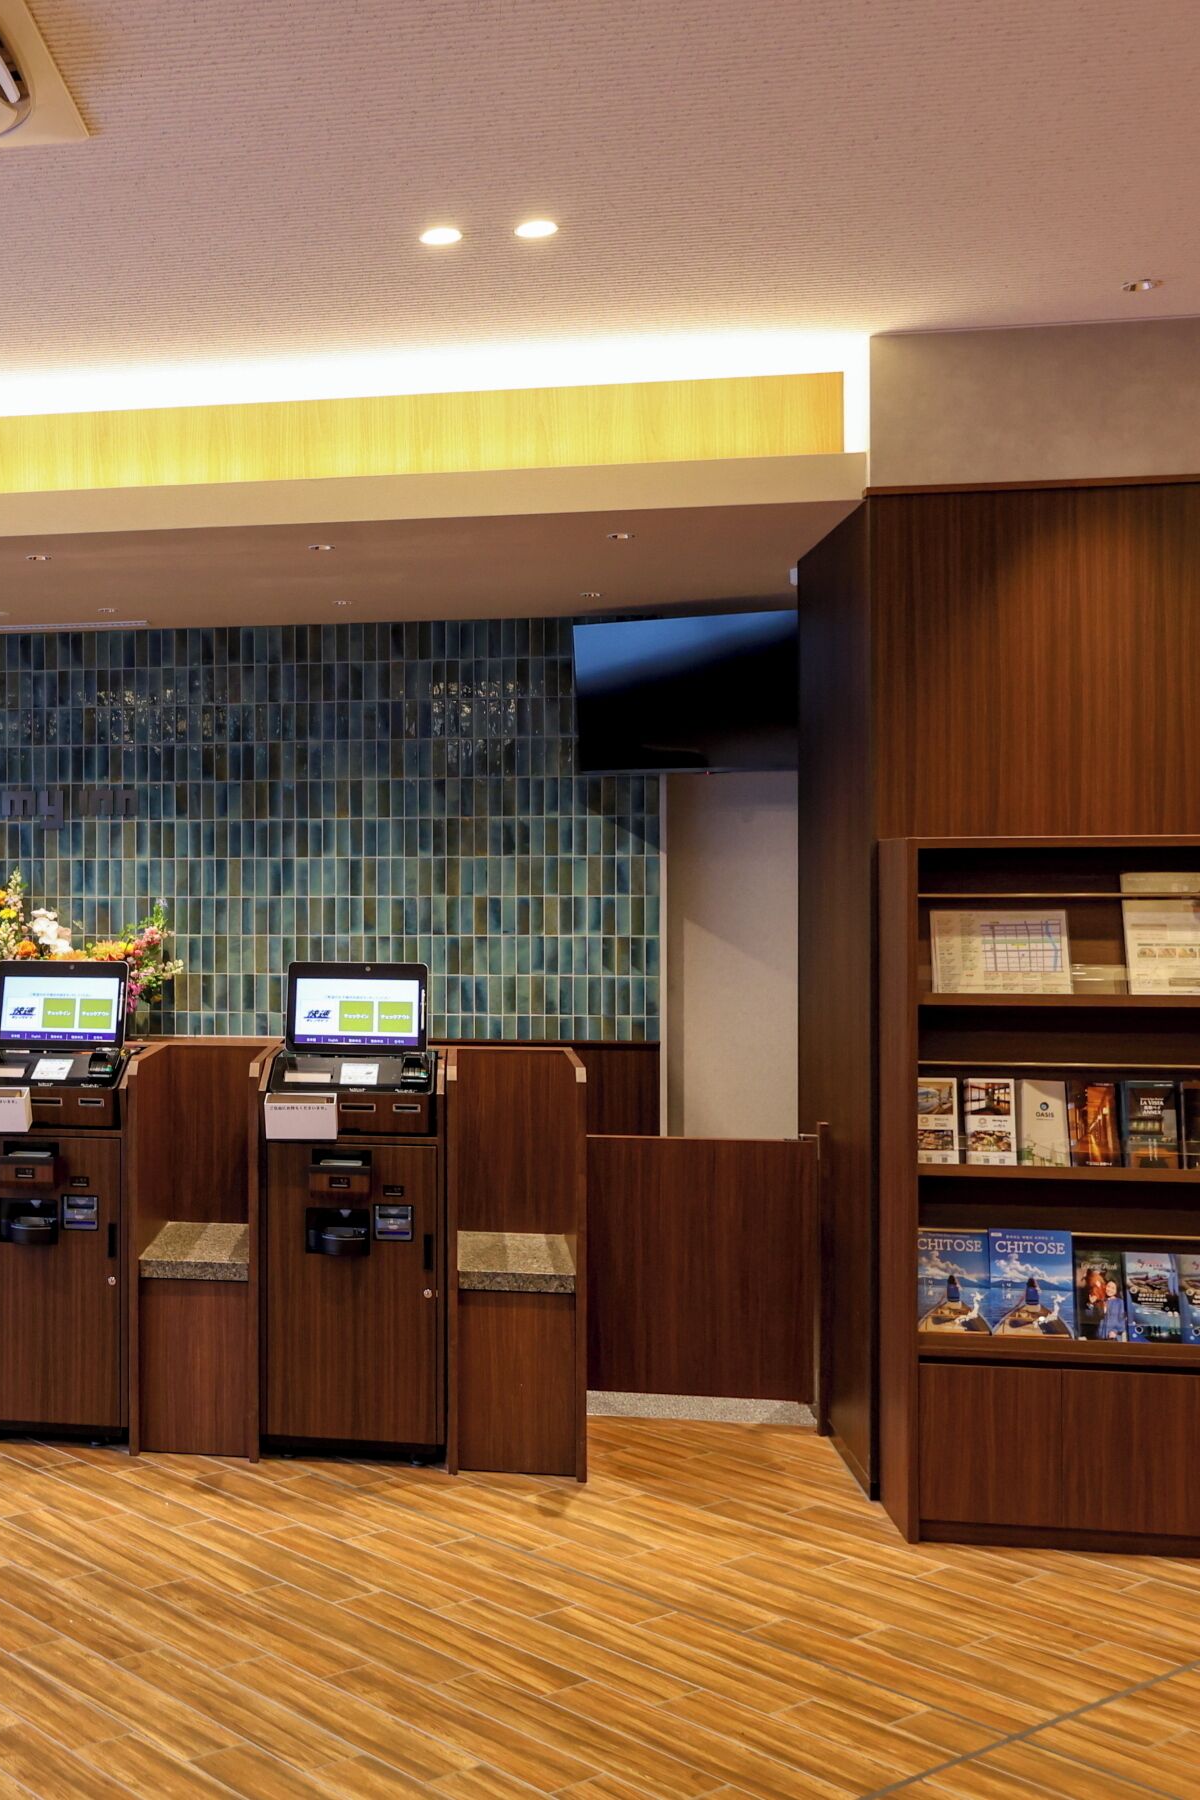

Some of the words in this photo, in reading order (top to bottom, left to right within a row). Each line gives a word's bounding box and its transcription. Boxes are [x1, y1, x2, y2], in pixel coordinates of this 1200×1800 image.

[79, 790, 138, 816] inn
[917, 1238, 983, 1253] CHITOSE
[995, 1240, 1066, 1256] CHITOSE
